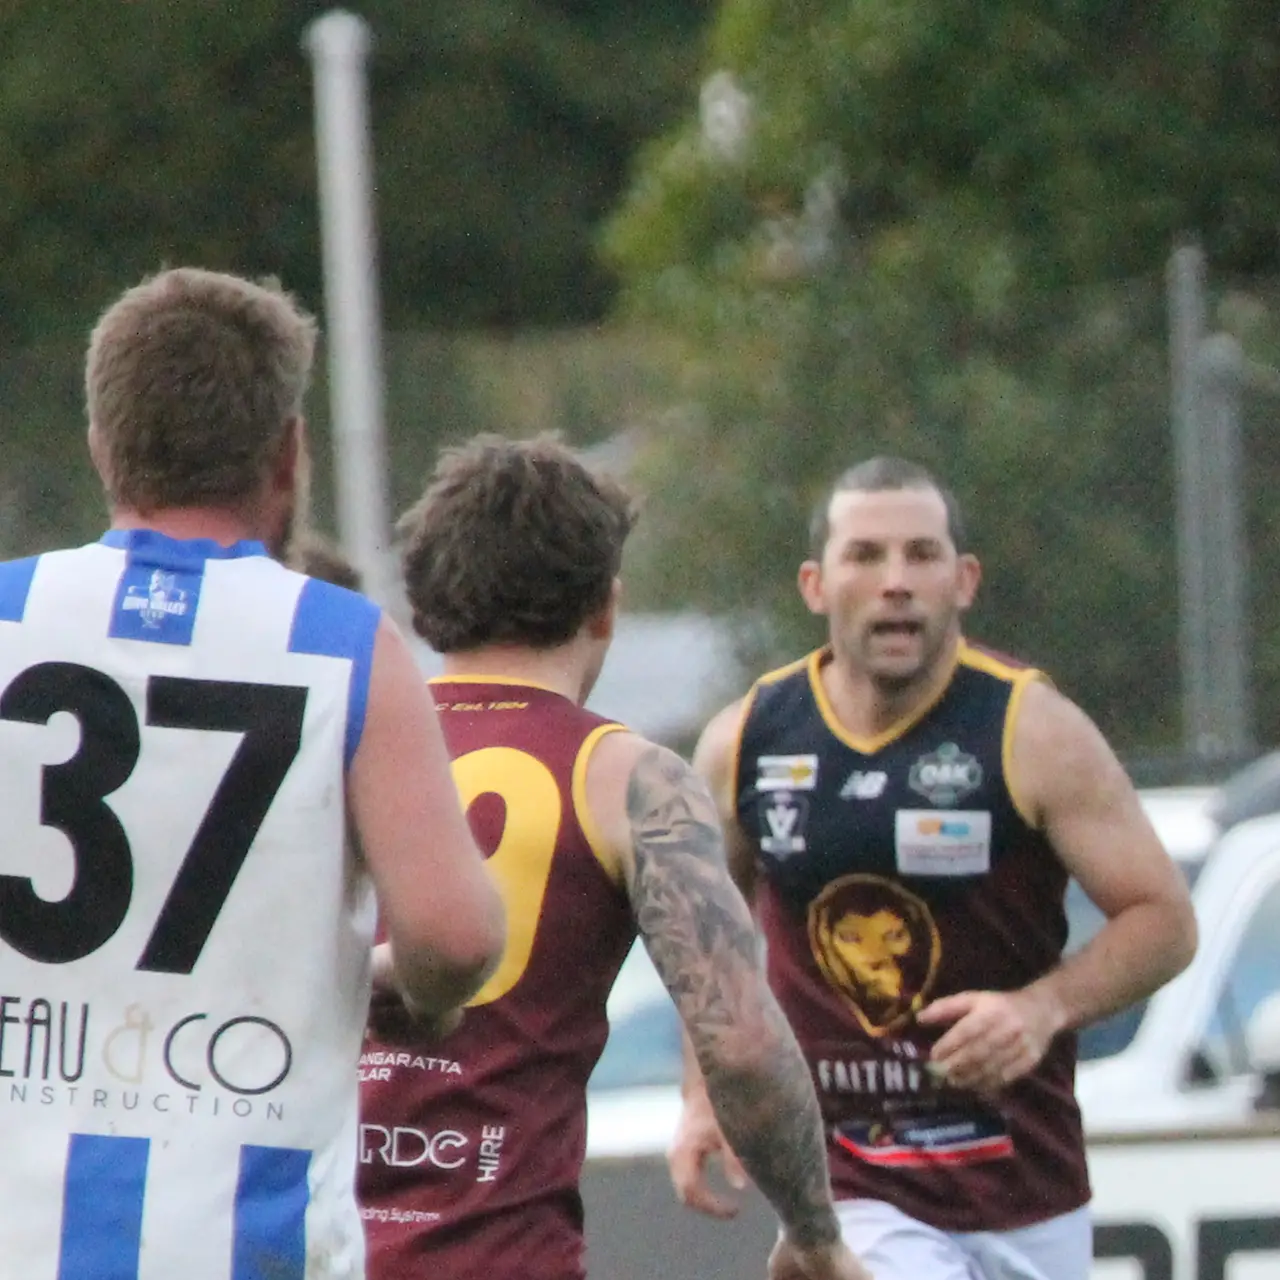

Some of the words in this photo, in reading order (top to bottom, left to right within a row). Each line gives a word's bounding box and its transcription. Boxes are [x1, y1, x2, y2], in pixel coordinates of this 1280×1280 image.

[0, 660, 310, 976] 37
[163, 1012, 293, 1096] CO
[359, 1123, 469, 1170] RDC
[476, 1124, 505, 1183] HIRE
